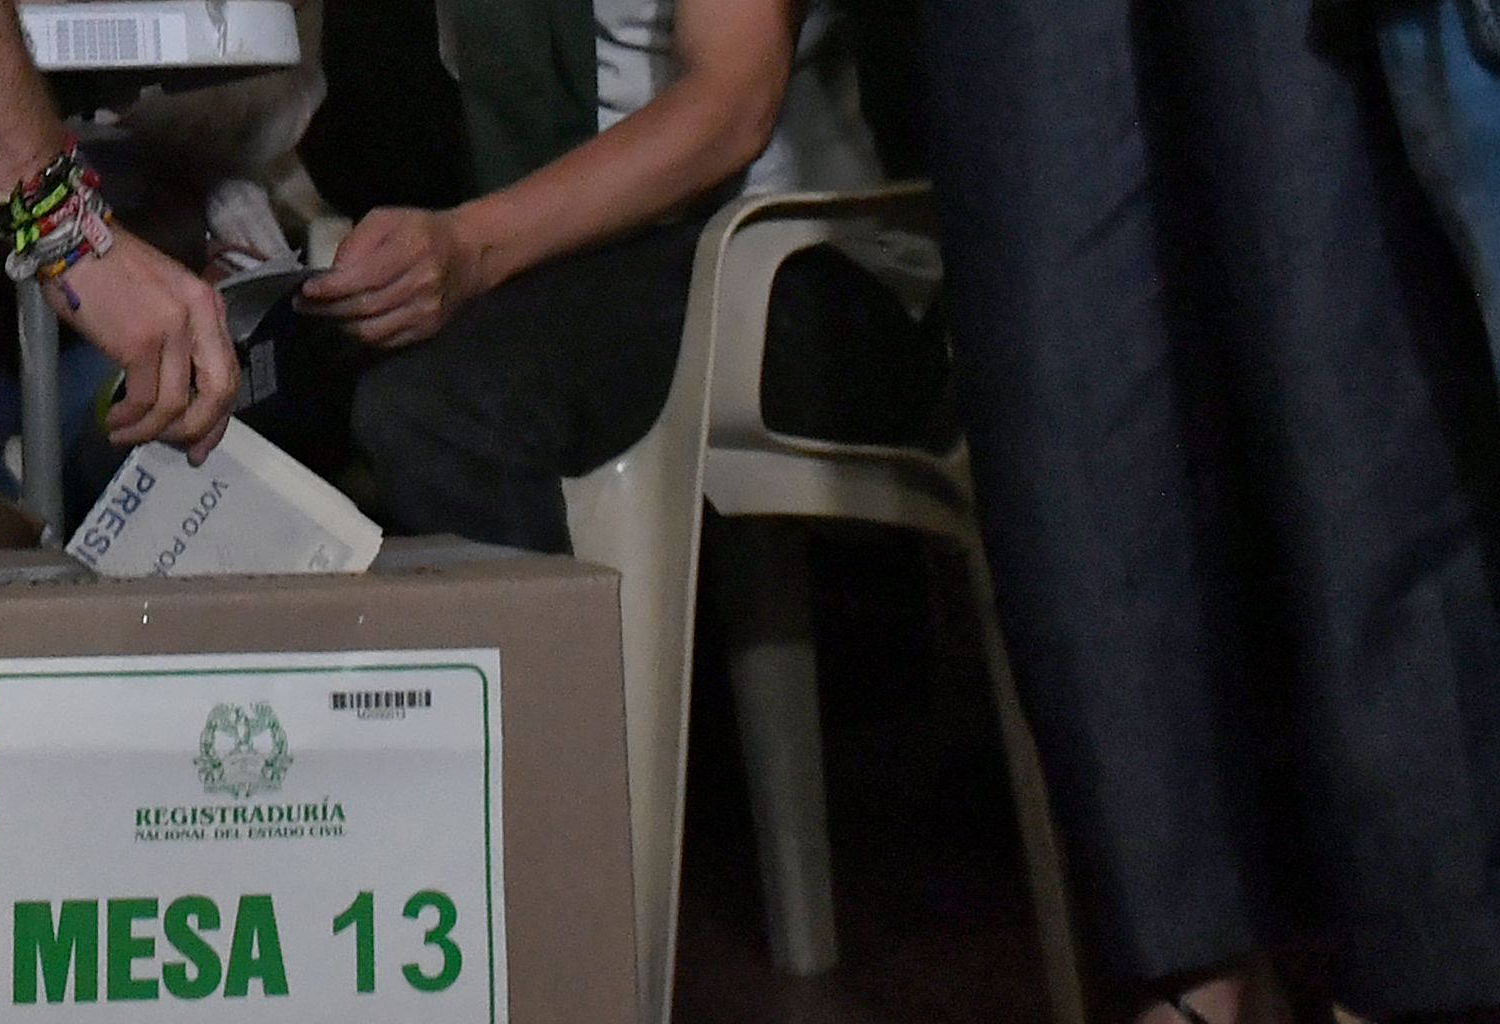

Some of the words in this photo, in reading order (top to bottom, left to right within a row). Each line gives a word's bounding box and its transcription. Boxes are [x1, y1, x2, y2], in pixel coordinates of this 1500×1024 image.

[182, 478, 229, 537] VOTO
[134, 794, 346, 827] REGISTRADURÍA
[134, 827, 207, 842] NACIONAL
[214, 827, 240, 840] DEL
[248, 825, 304, 839] ESTADO
[309, 824, 347, 837] CIVIL
[13, 894, 289, 1004] MESA
[332, 889, 463, 994] 13
